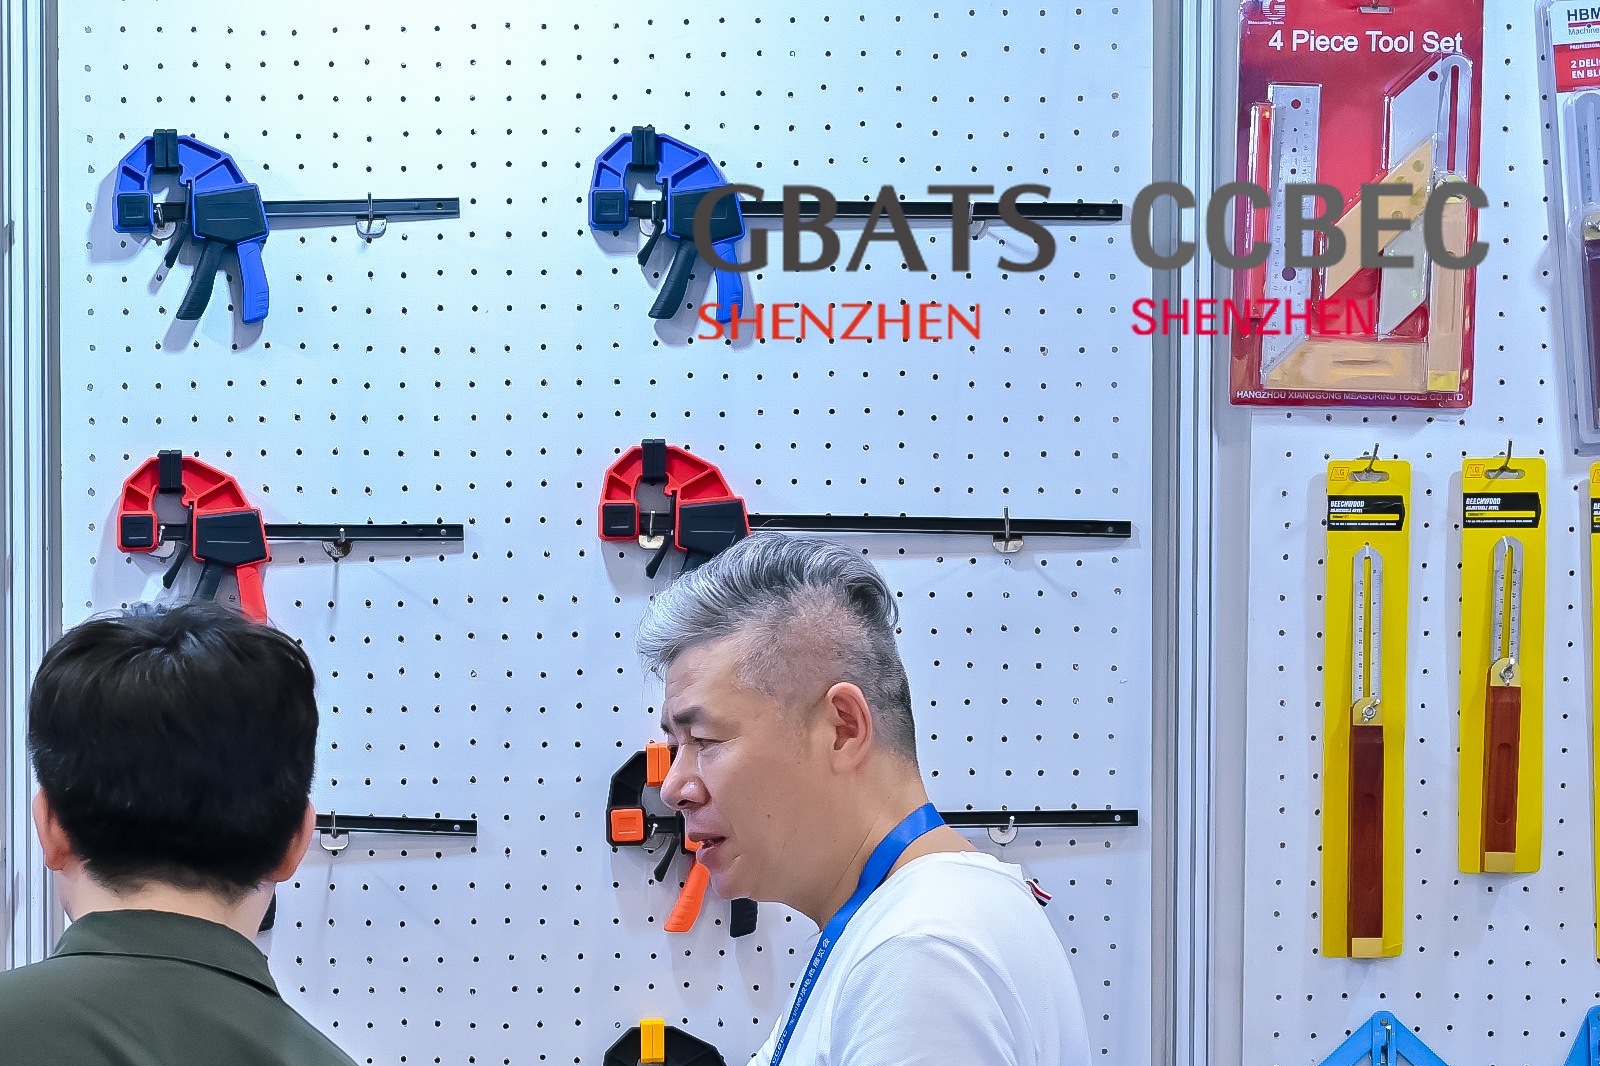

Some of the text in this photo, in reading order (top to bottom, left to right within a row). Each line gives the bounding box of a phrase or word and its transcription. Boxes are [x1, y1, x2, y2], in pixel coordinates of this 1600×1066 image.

[1268, 29, 1463, 54] 4 Piece Tool Set
[1570, 60, 1577, 69] 2
[1571, 70, 1585, 79] EN
